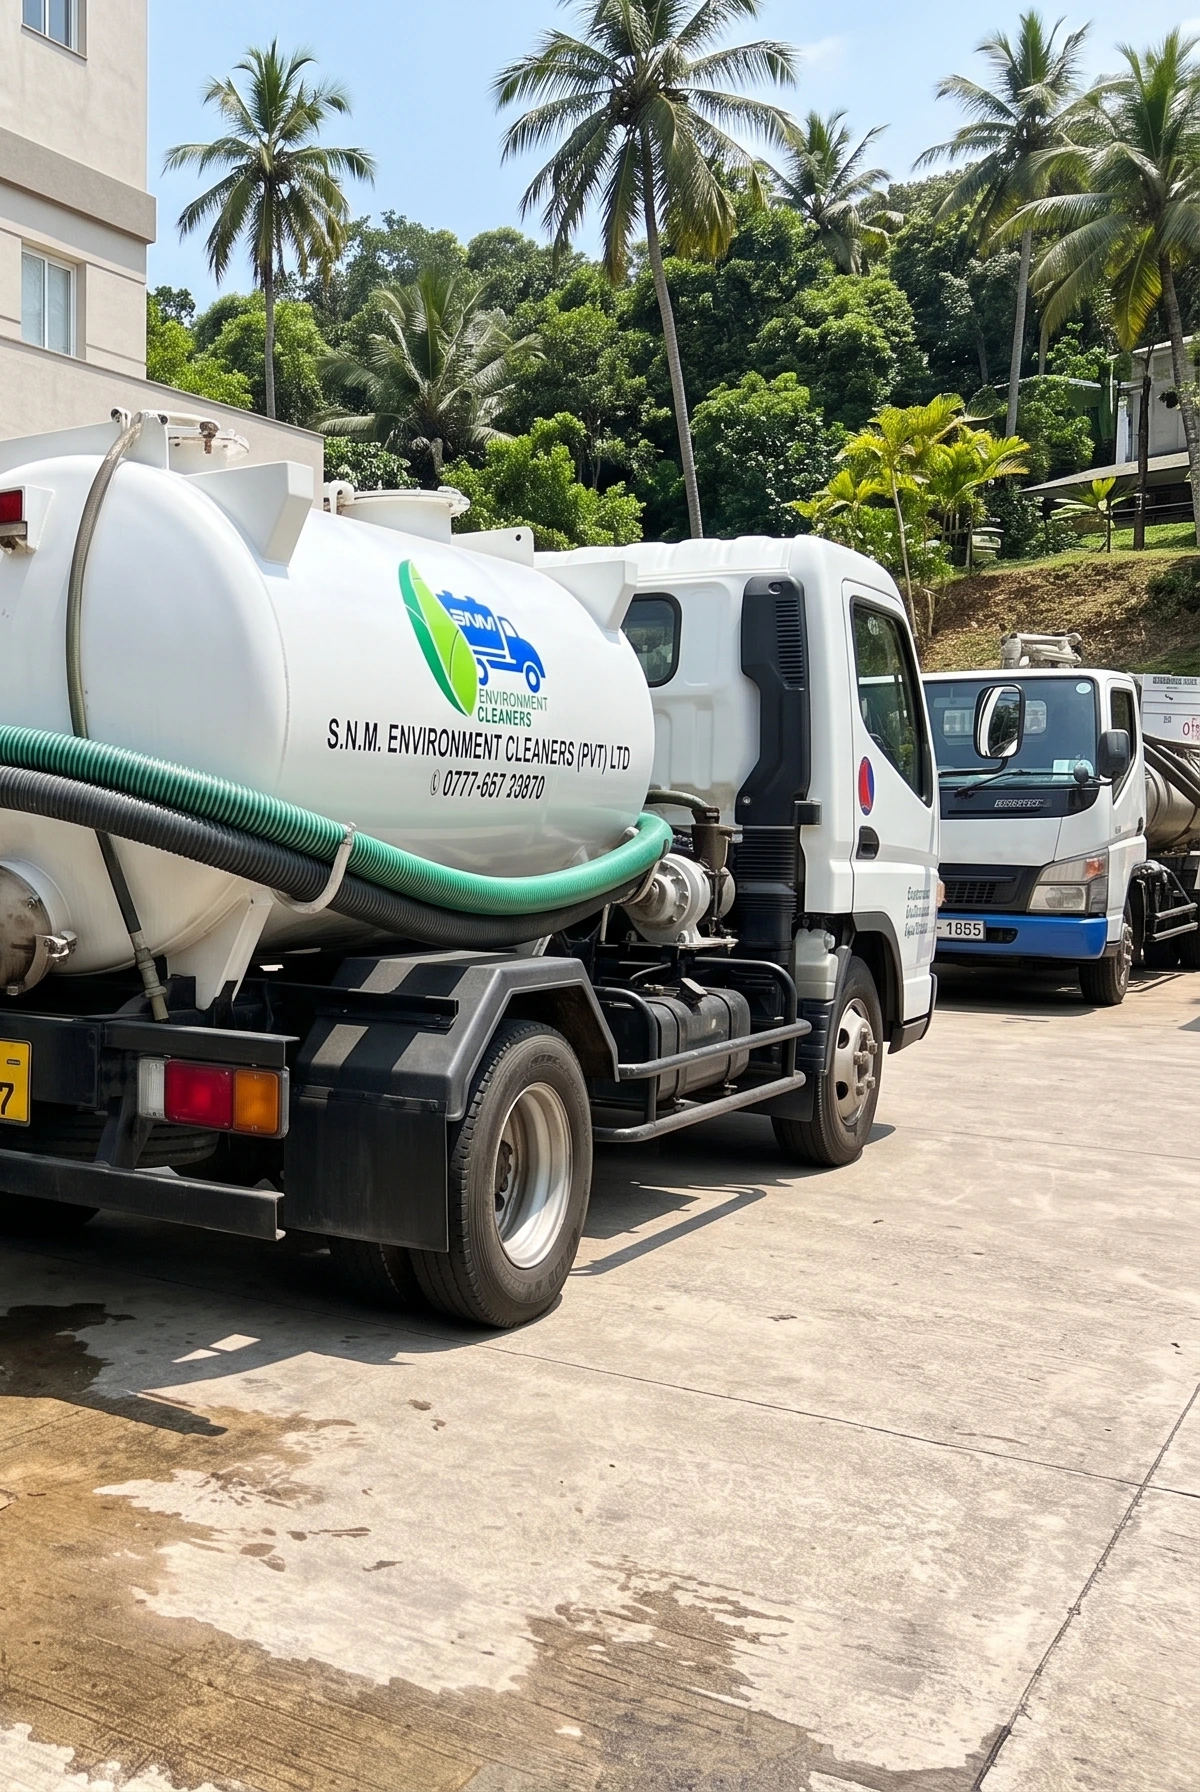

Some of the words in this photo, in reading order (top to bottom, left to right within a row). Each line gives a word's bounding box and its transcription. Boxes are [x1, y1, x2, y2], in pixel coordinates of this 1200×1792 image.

[449, 608, 497, 631] SNM
[478, 688, 548, 711] ENVIRONMENT
[477, 706, 532, 728] CLEANERS
[327, 717, 382, 752] S.N.M.
[387, 724, 502, 761] ENVIRONMENT
[505, 735, 575, 767] CLEANERS
[577, 742, 607, 775] (PVT)
[609, 745, 631, 771] LTD
